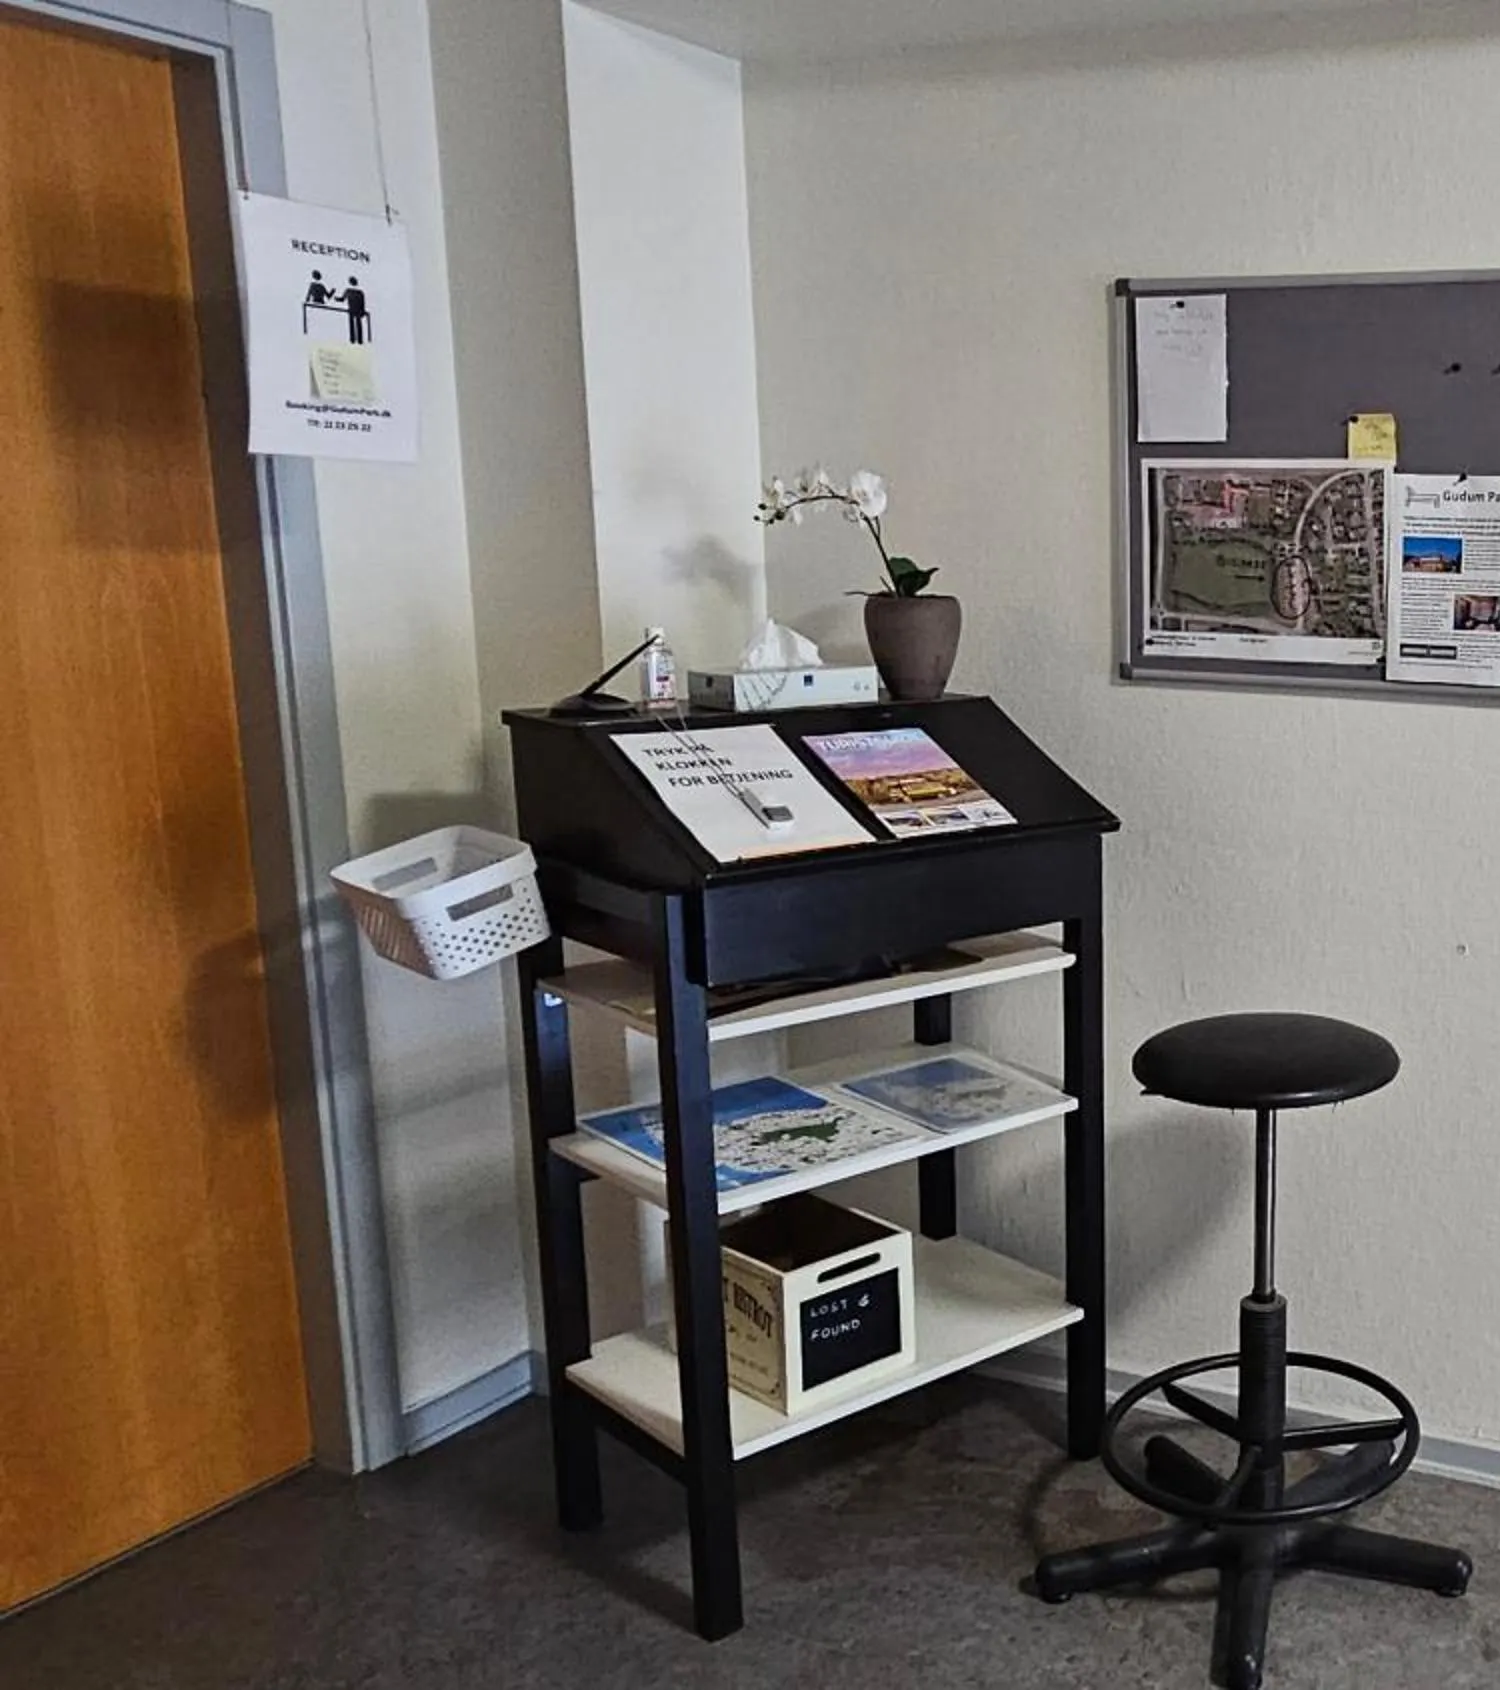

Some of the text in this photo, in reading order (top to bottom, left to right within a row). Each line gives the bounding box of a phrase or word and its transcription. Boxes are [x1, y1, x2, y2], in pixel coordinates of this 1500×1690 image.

[290, 238, 371, 262] RECEPTION
[1442, 489, 1485, 502] Gudum
[643, 747, 689, 757] TRYK
[668, 769, 793, 787] FOR BETJENING
[810, 1299, 849, 1318] LOST
[810, 1318, 862, 1341] FOUND
